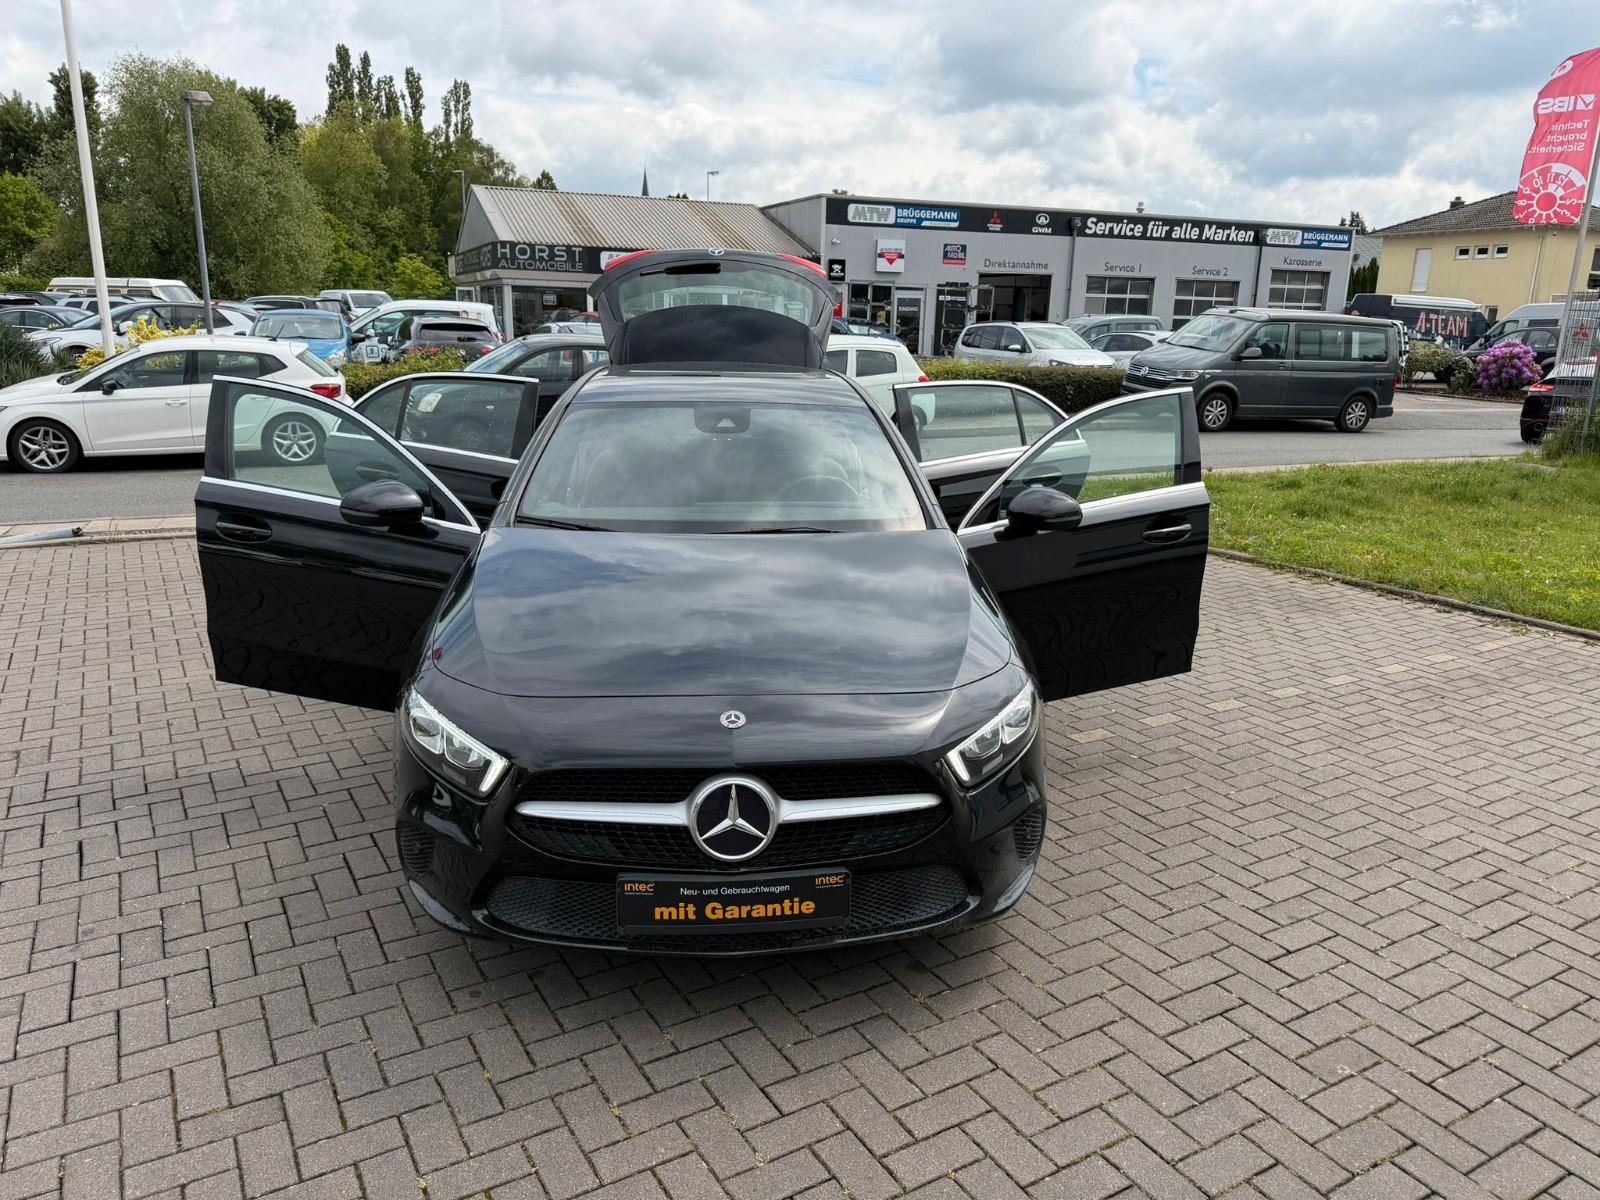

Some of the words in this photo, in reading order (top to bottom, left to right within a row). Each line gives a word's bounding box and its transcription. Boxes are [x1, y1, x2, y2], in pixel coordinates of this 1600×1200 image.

[851, 205, 892, 222] MTW
[897, 208, 958, 220] BRÜGGEMANN
[1032, 226, 1052, 234] GWM
[1085, 217, 1143, 237] Service
[1146, 219, 1169, 239] für
[1171, 222, 1199, 240] alle
[1202, 224, 1255, 243] Marken
[1303, 231, 1349, 242] BRÜGGEMANN
[498, 243, 583, 262] HORST
[498, 259, 583, 272] AUTOMOBILE
[984, 258, 1049, 271] Direktannahme
[1104, 262, 1136, 273] Service
[1283, 256, 1323, 267] Karosserie
[1192, 265, 1221, 276] Service
[1222, 267, 1229, 277] 2
[1416, 311, 1468, 338] A-TEAM
[815, 875, 845, 885] intec
[624, 883, 654, 893] intec
[680, 887, 701, 895] Neu-
[702, 887, 719, 895] und
[720, 884, 790, 896] Gebrauchtwagen
[655, 902, 696, 920] mit
[704, 897, 816, 920] Garantie
